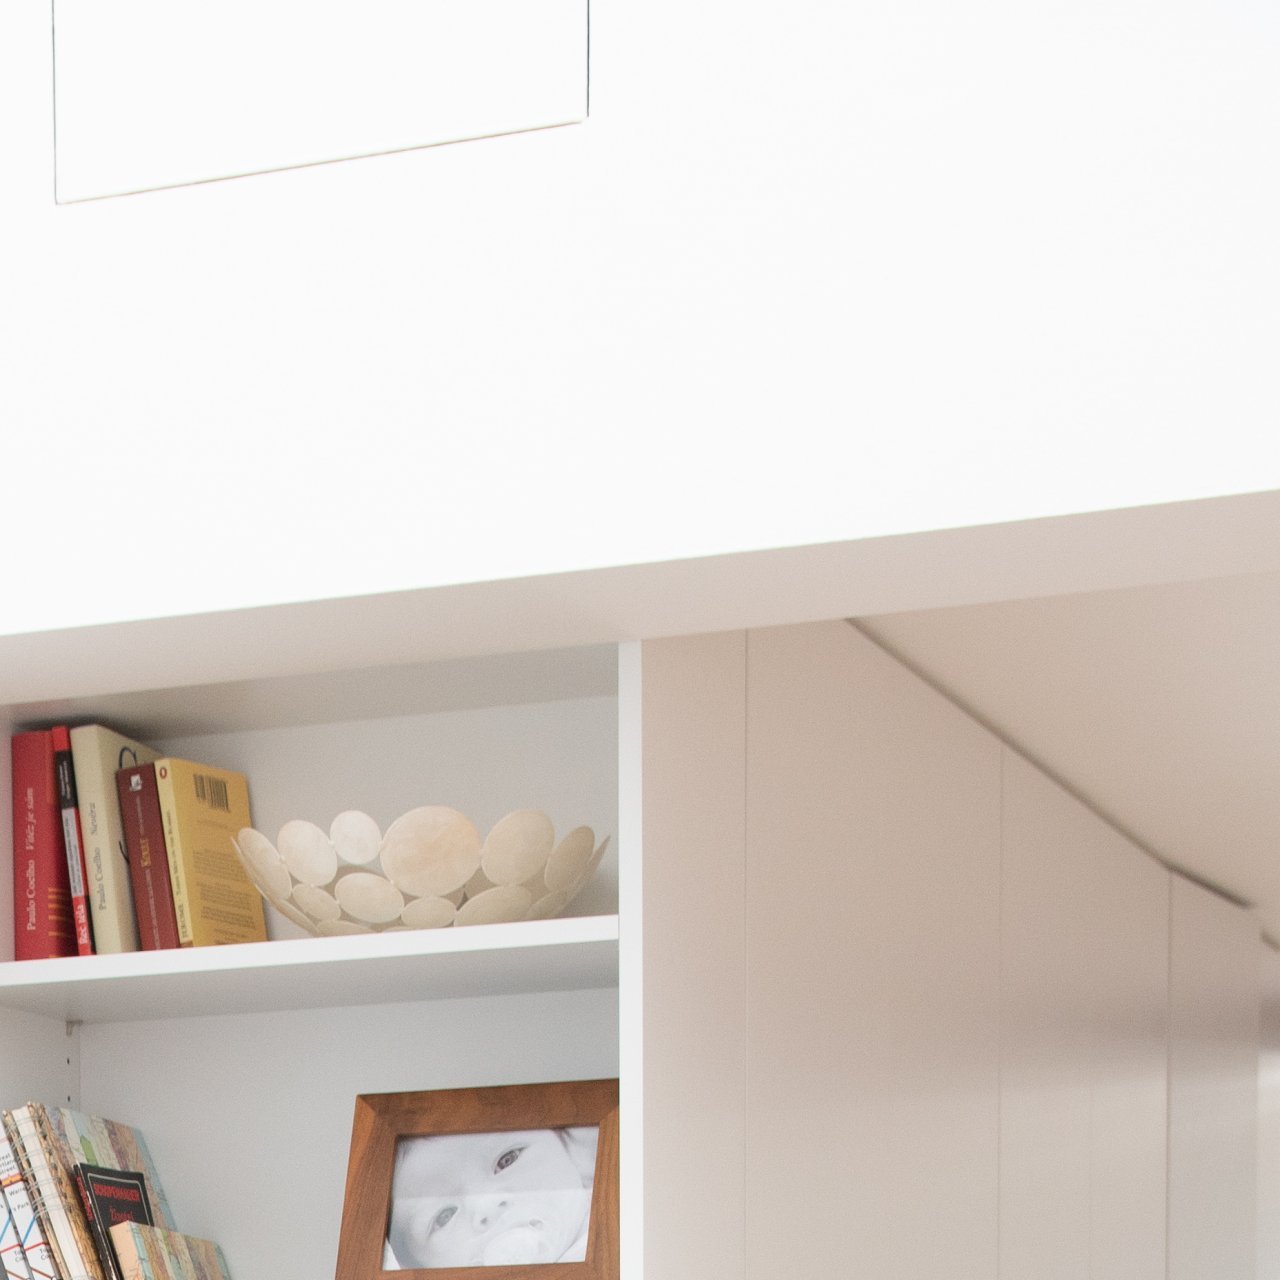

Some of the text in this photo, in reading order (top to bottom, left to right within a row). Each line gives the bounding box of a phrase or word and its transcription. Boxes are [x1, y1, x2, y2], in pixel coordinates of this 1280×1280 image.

[93, 847, 104, 881] Coelho
[26, 859, 36, 931] Paulo Coelho
